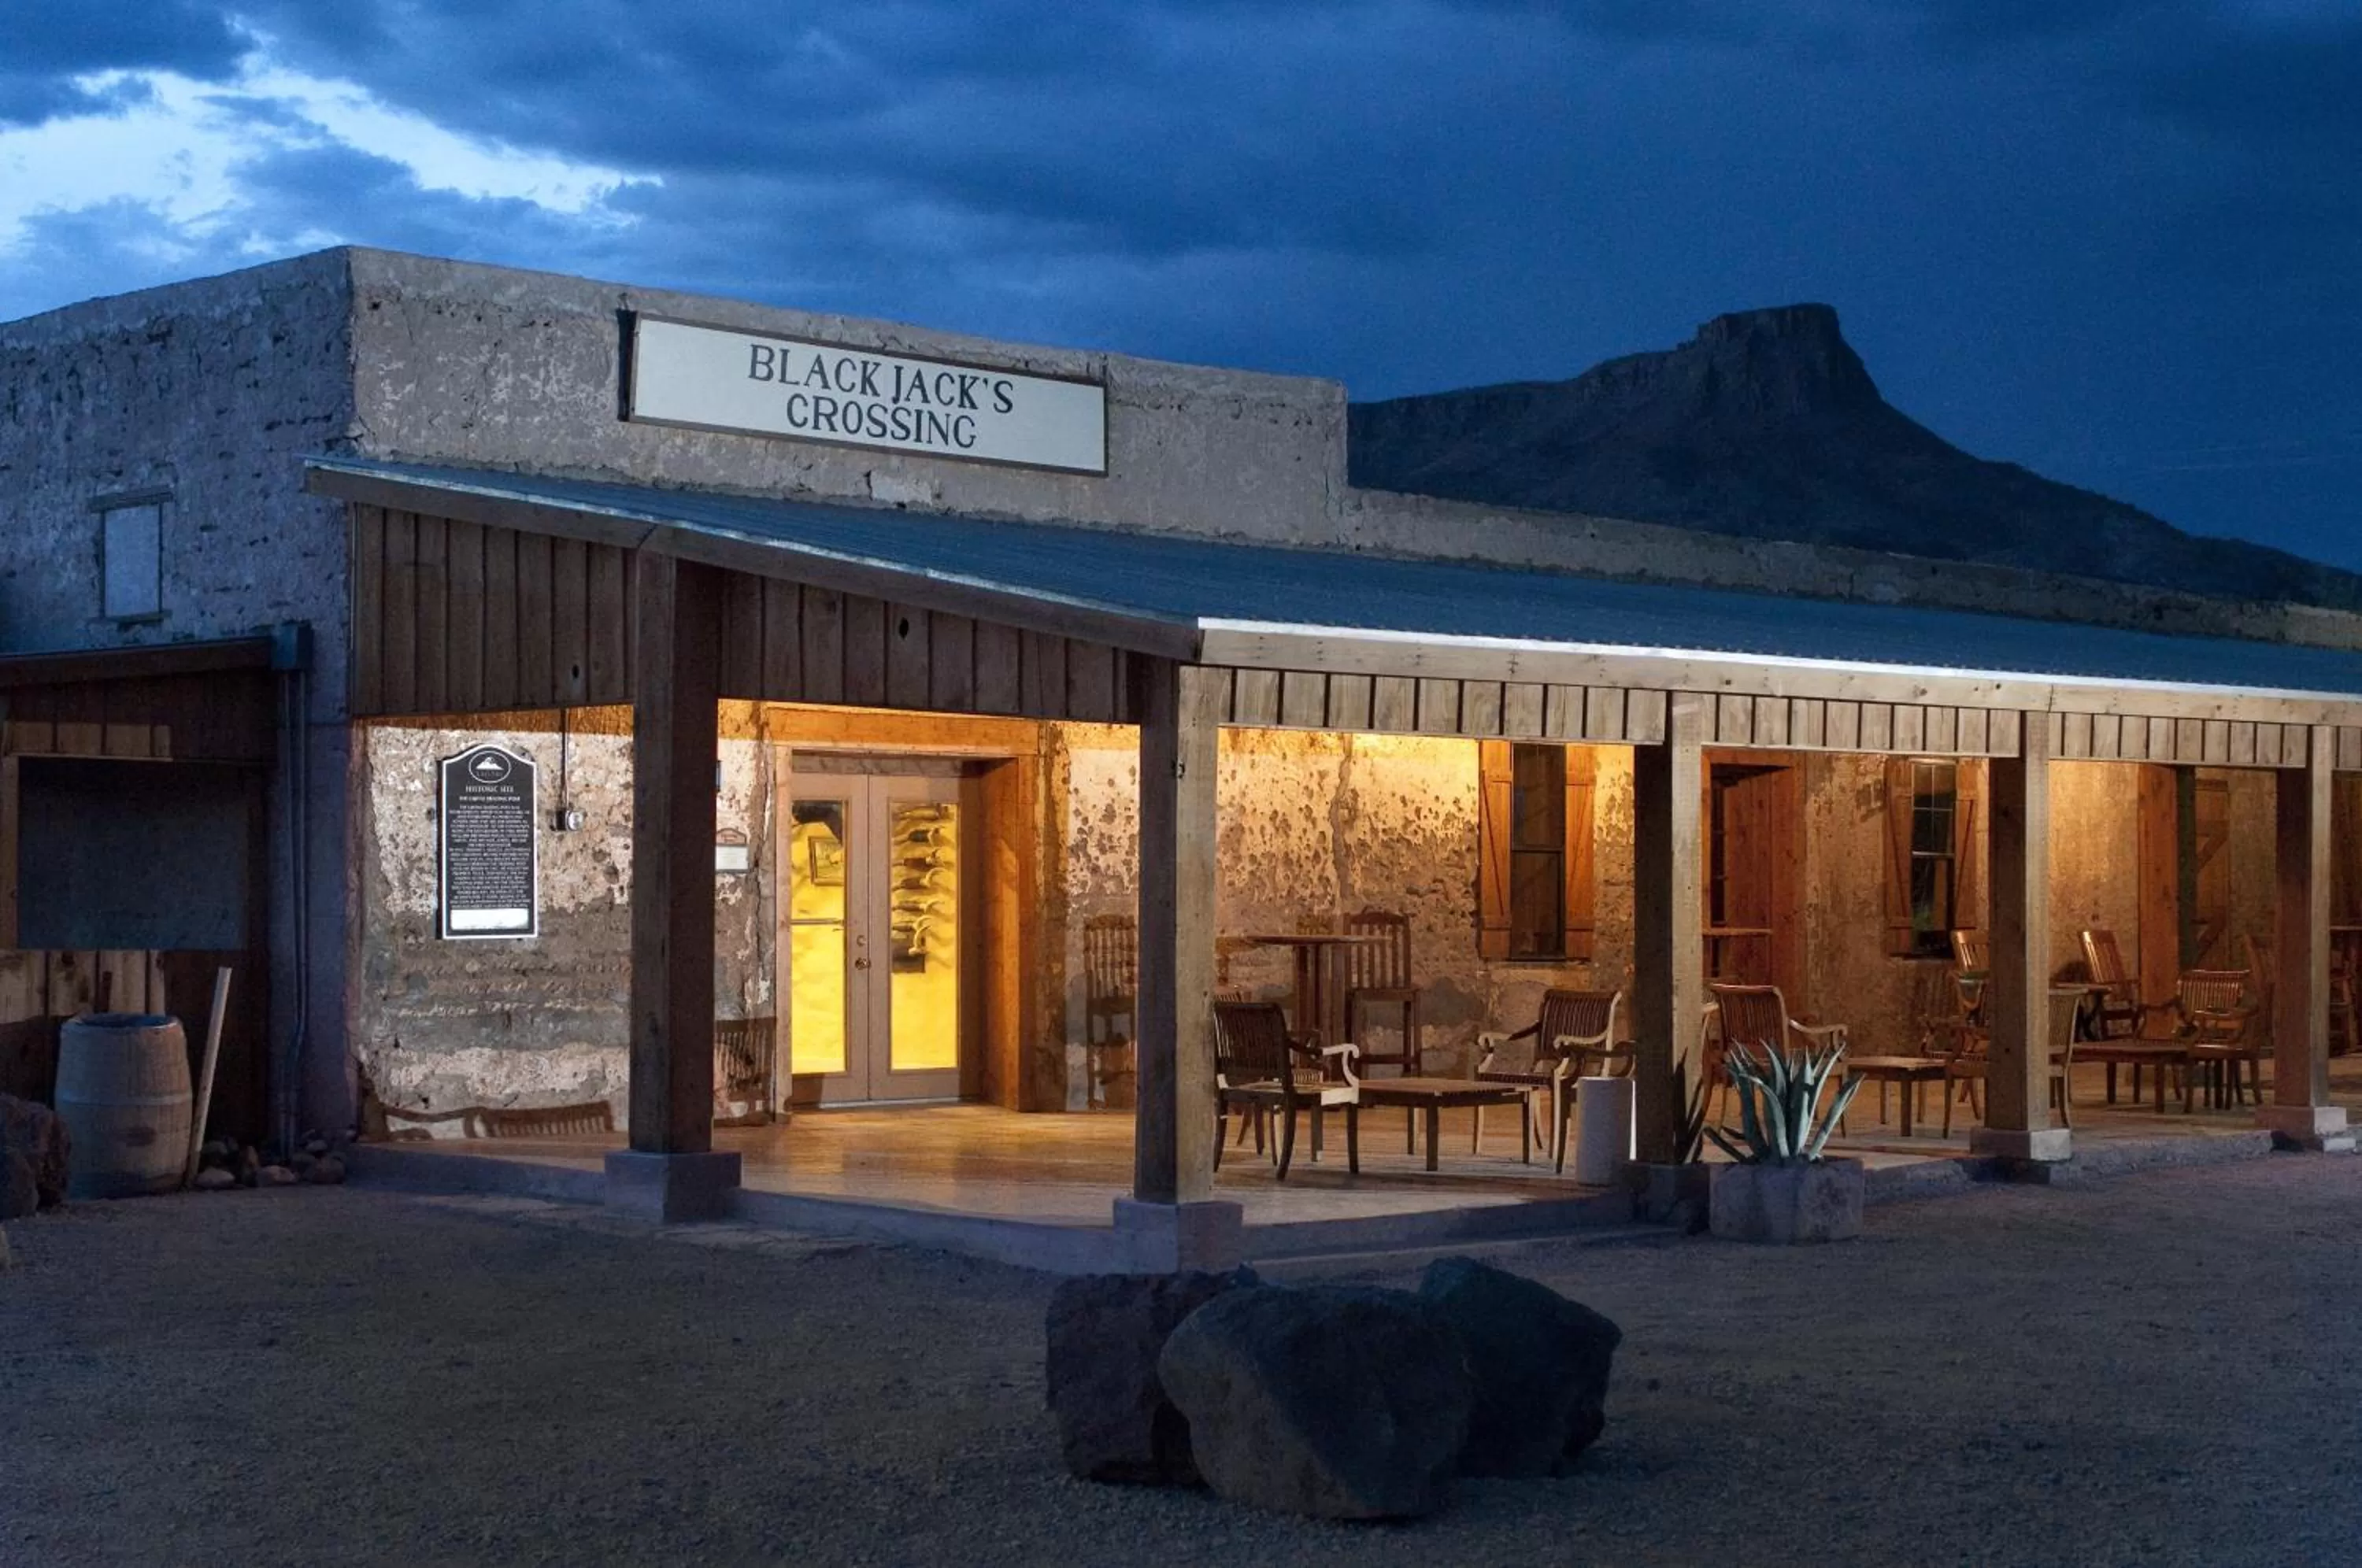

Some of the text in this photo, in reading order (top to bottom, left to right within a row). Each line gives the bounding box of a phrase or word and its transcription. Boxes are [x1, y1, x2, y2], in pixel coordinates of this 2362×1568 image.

[748, 343, 1014, 414] BLACK JACK'S
[787, 393, 977, 449] CROSSING
